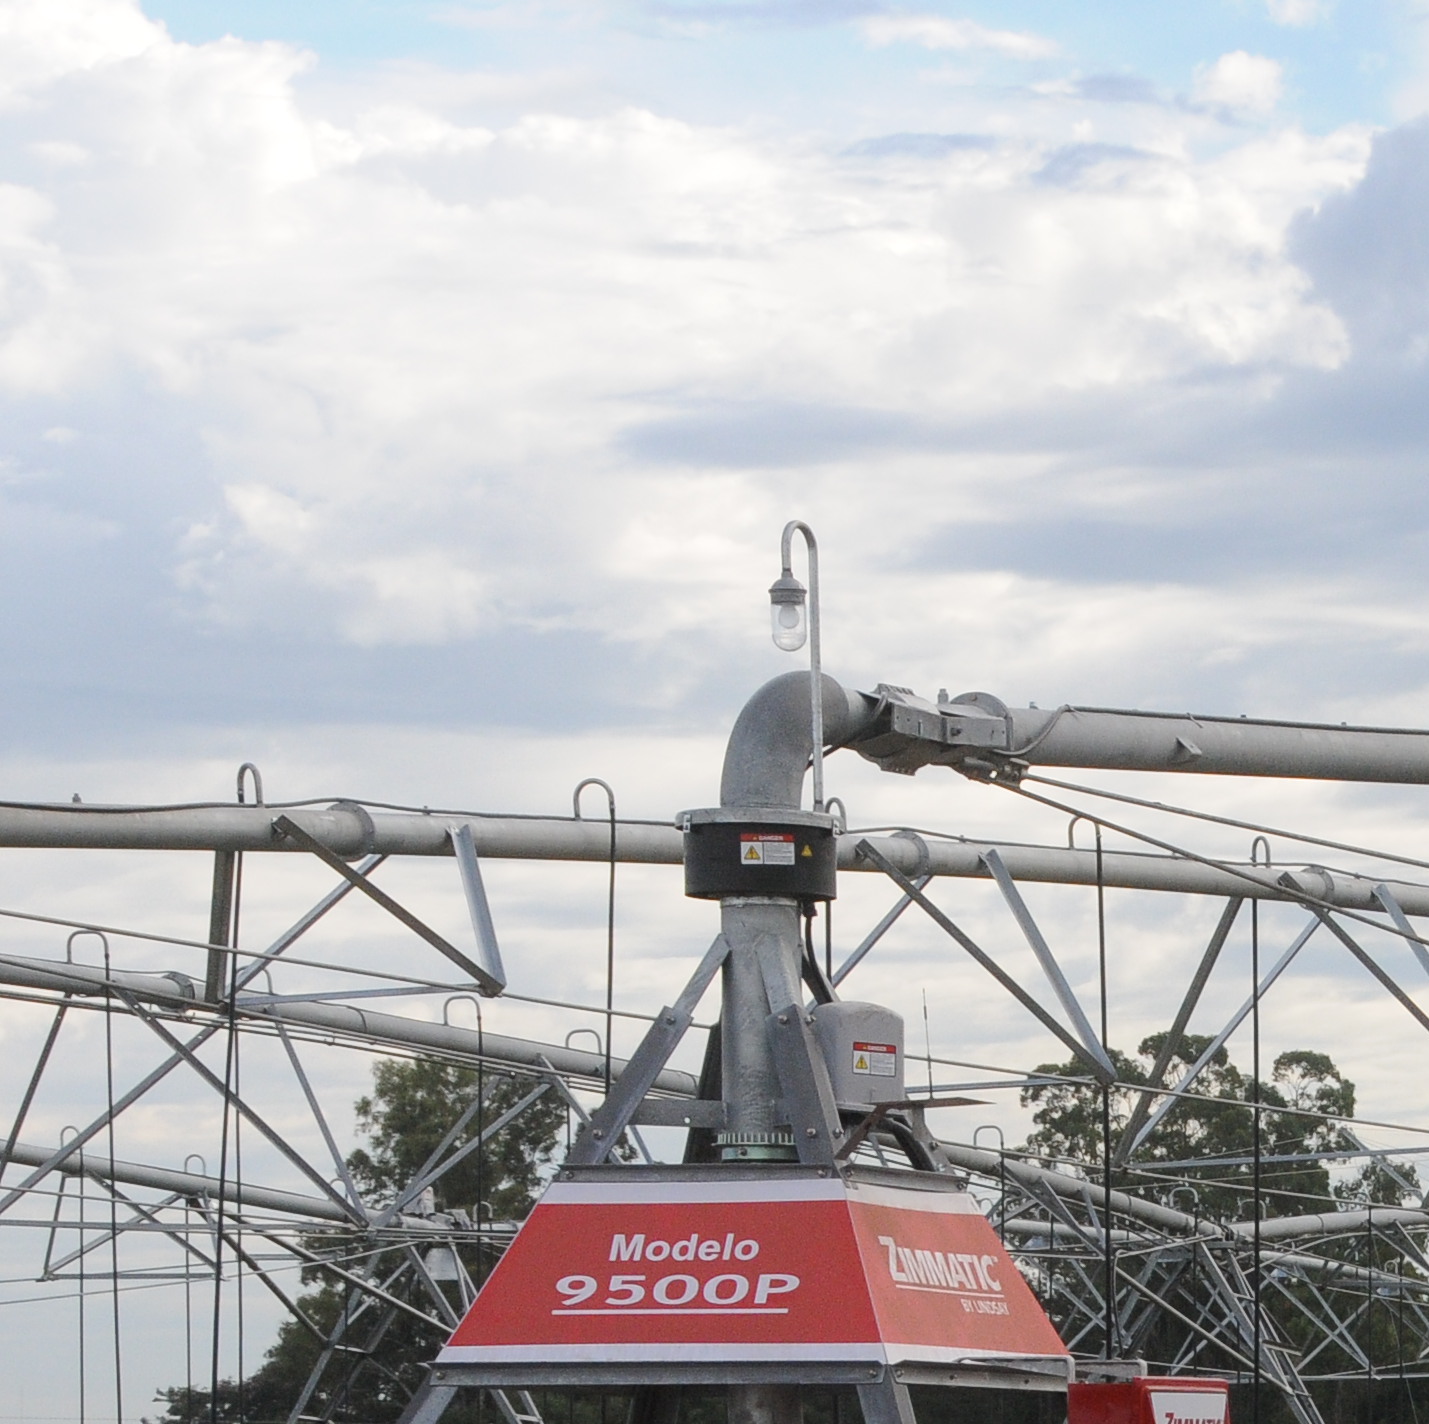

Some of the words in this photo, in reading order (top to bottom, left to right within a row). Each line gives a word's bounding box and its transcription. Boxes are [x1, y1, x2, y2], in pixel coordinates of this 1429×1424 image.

[609, 1233, 760, 1262] Modelo
[555, 1273, 801, 1306] 9500P
[961, 1299, 975, 1313] BY
[975, 1300, 1010, 1316] LINDSAY
